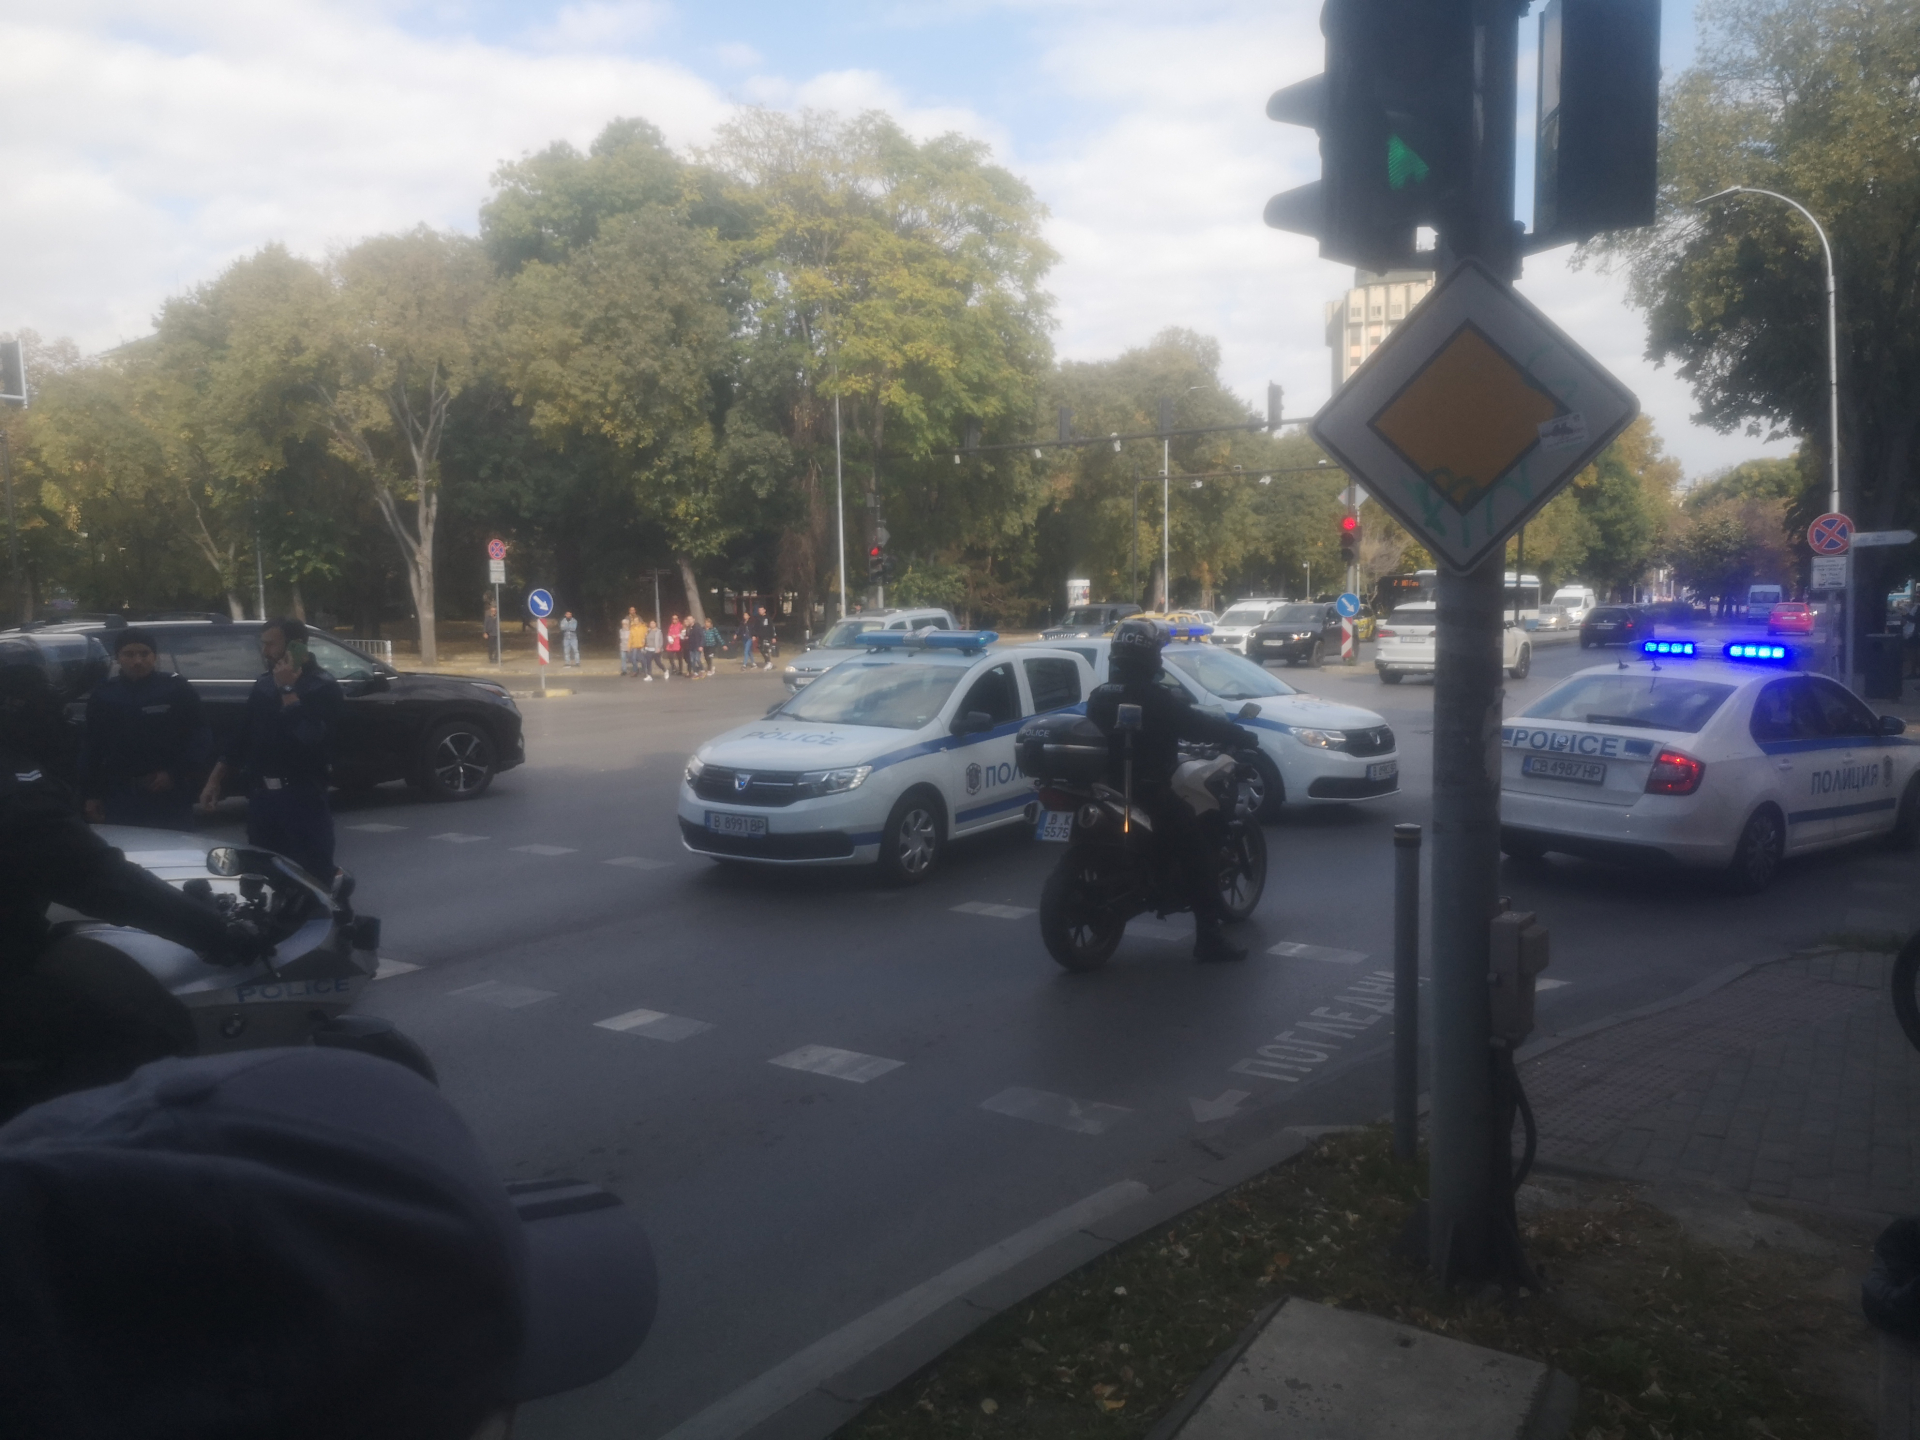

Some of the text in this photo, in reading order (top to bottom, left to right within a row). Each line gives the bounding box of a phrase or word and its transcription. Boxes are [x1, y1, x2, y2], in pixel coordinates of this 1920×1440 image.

[741, 731, 844, 746] POLICE
[1018, 728, 1051, 738] POLICE
[1512, 729, 1619, 757] POLICE
[1811, 764, 1878, 795] ПОЛИЦИЯ
[1044, 826, 1069, 838] 5575
[236, 978, 350, 1003] POLICE
